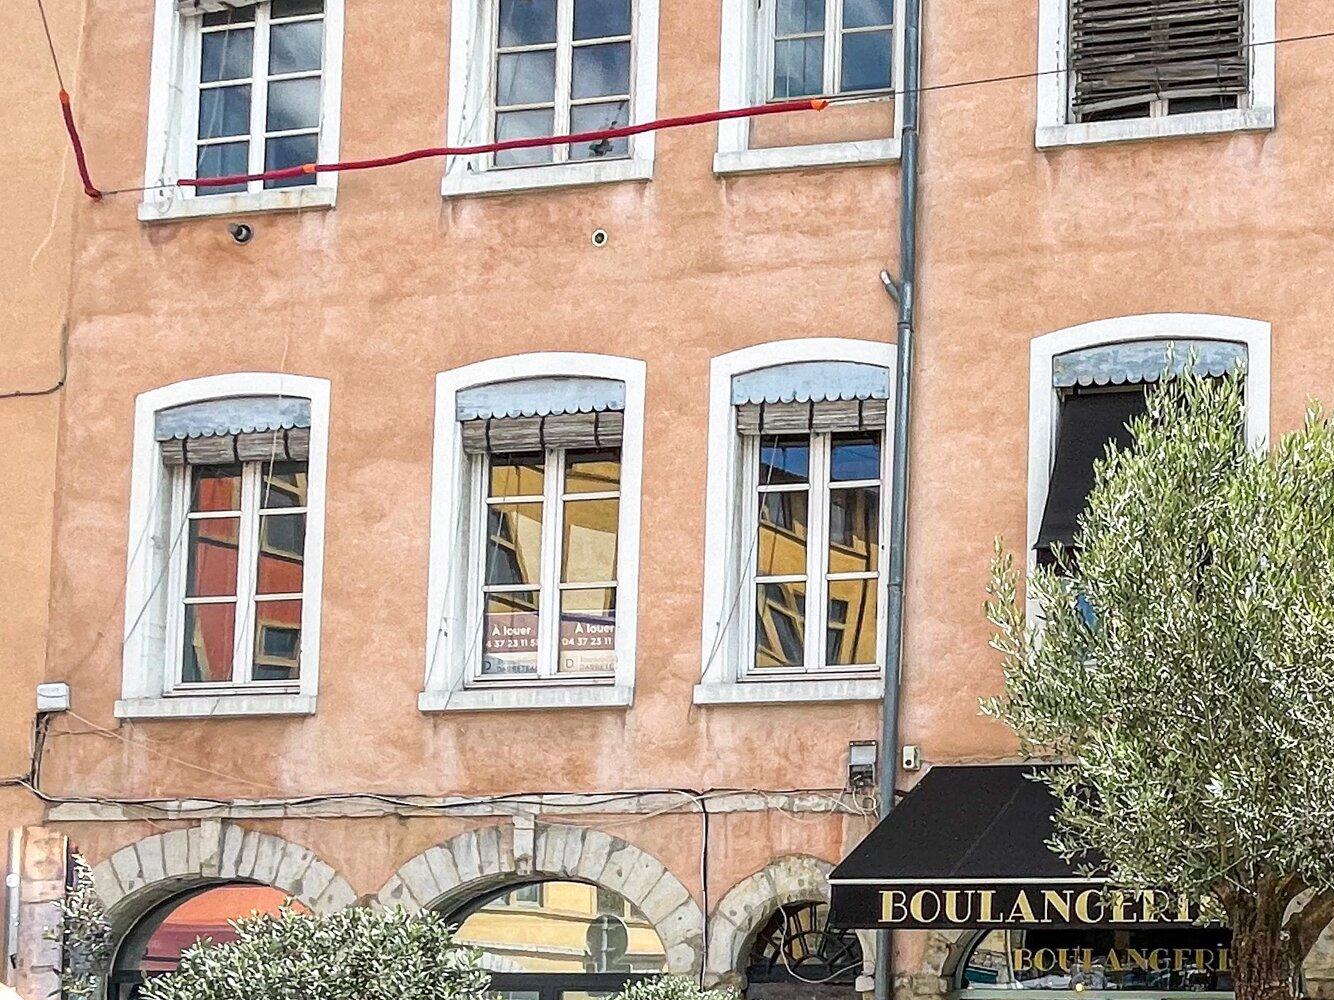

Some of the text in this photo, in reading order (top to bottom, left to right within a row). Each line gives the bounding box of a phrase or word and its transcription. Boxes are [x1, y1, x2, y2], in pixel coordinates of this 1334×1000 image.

[504, 625, 532, 636] louer
[586, 623, 615, 634] louer
[878, 889, 1221, 924] BOULANGERI
